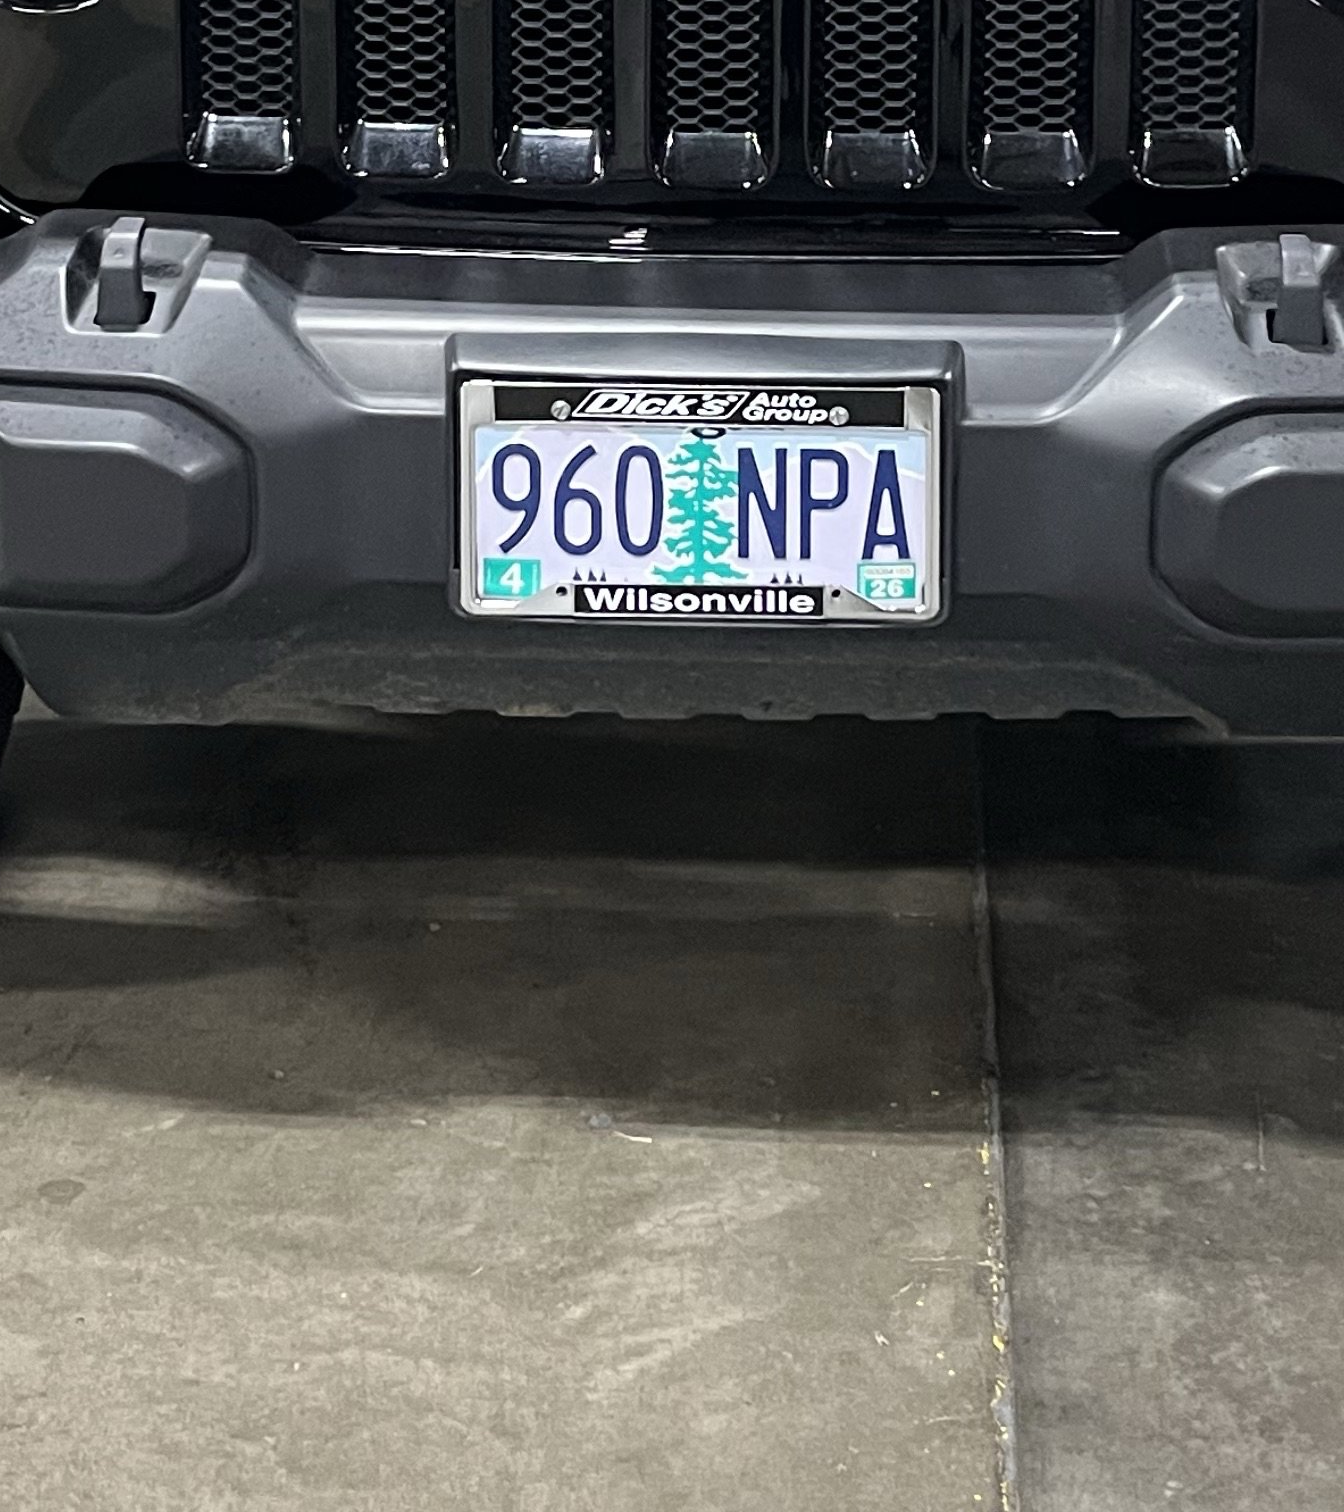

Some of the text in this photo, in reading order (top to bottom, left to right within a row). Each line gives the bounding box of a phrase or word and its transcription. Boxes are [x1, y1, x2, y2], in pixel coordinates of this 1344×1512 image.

[748, 391, 817, 409] Auto
[742, 405, 829, 425] Group
[492, 443, 910, 560] 960 NPA
[499, 562, 525, 593] 4
[870, 578, 905, 598] 26
[584, 587, 816, 614] Wilsonville
